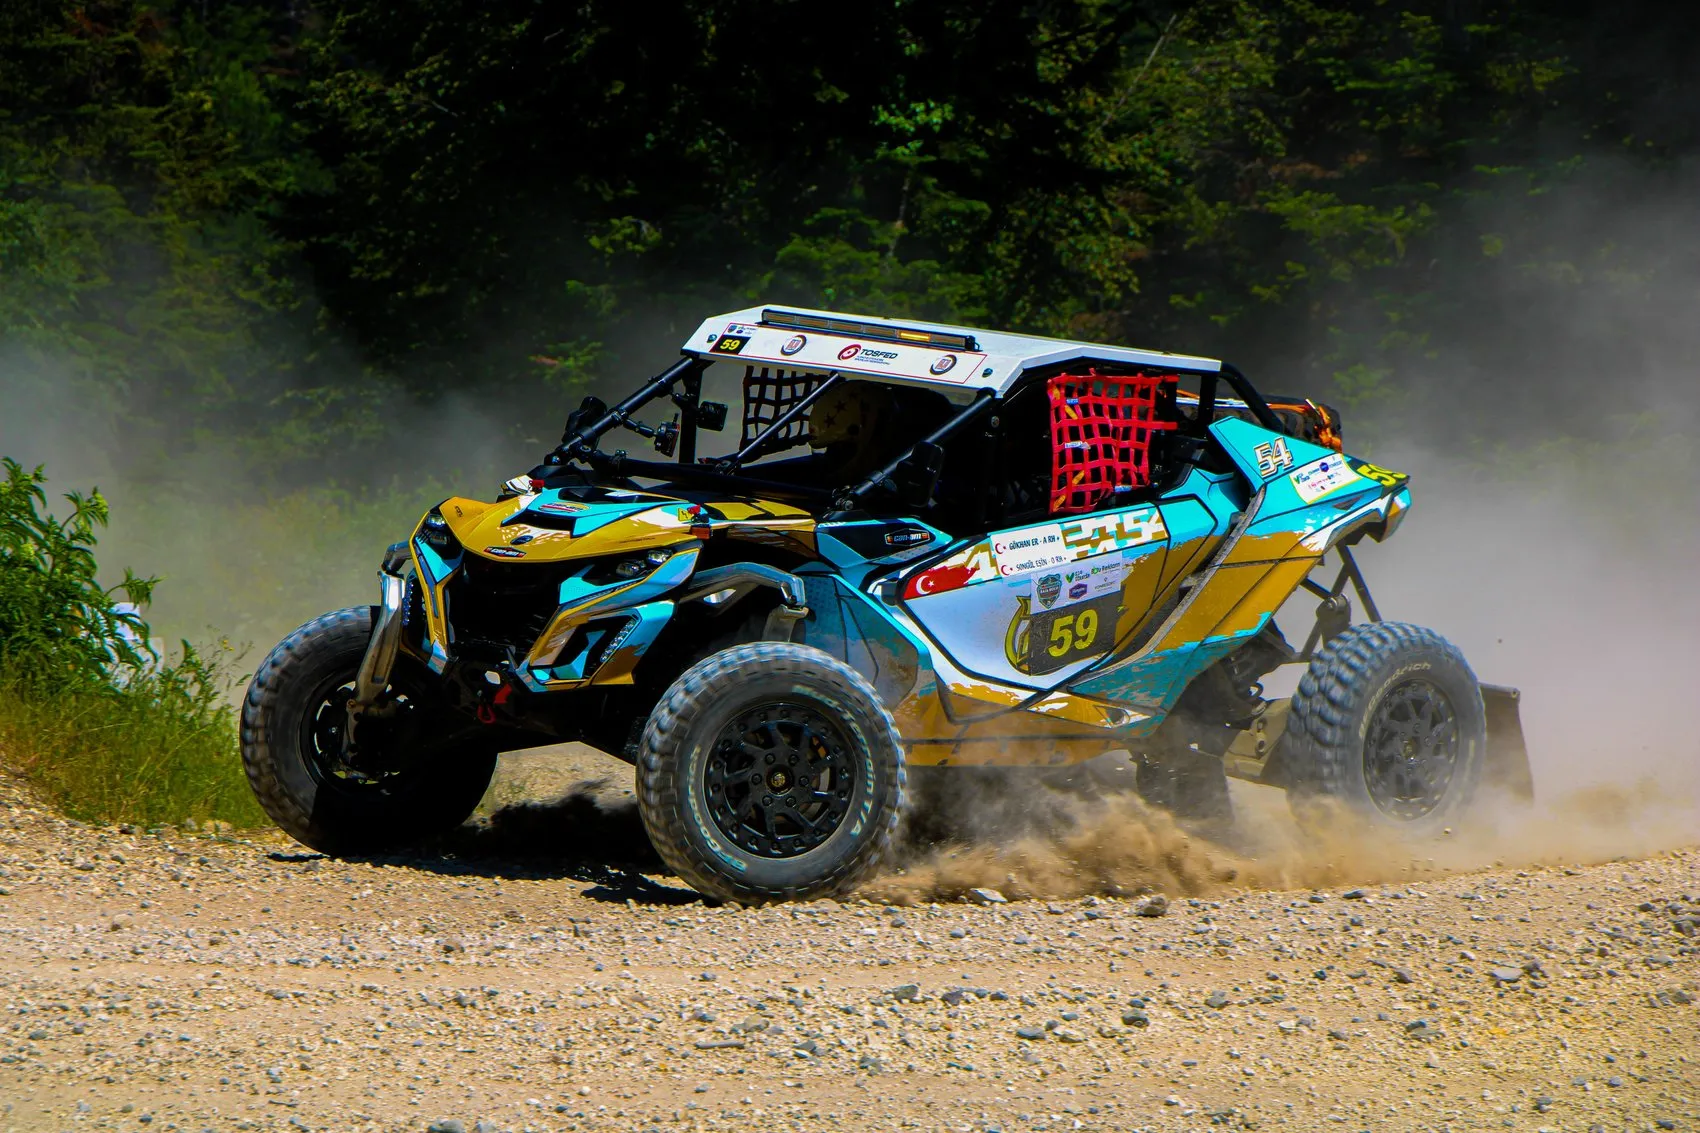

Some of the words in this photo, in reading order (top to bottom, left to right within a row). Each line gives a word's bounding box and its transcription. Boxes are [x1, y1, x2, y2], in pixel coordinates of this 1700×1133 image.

[719, 338, 741, 351] 59
[860, 348, 899, 359] TOSFED
[1253, 436, 1295, 478] 54
[1008, 538, 1031, 551] GÖKHAN
[1031, 537, 1040, 547] ER
[1042, 536, 1047, 544] A
[1048, 534, 1056, 543] RH
[1015, 559, 1035, 572] SONGÜL
[1047, 609, 1098, 658] 59
[686, 744, 748, 872] BFGoodrich
[849, 800, 873, 837] T/A
